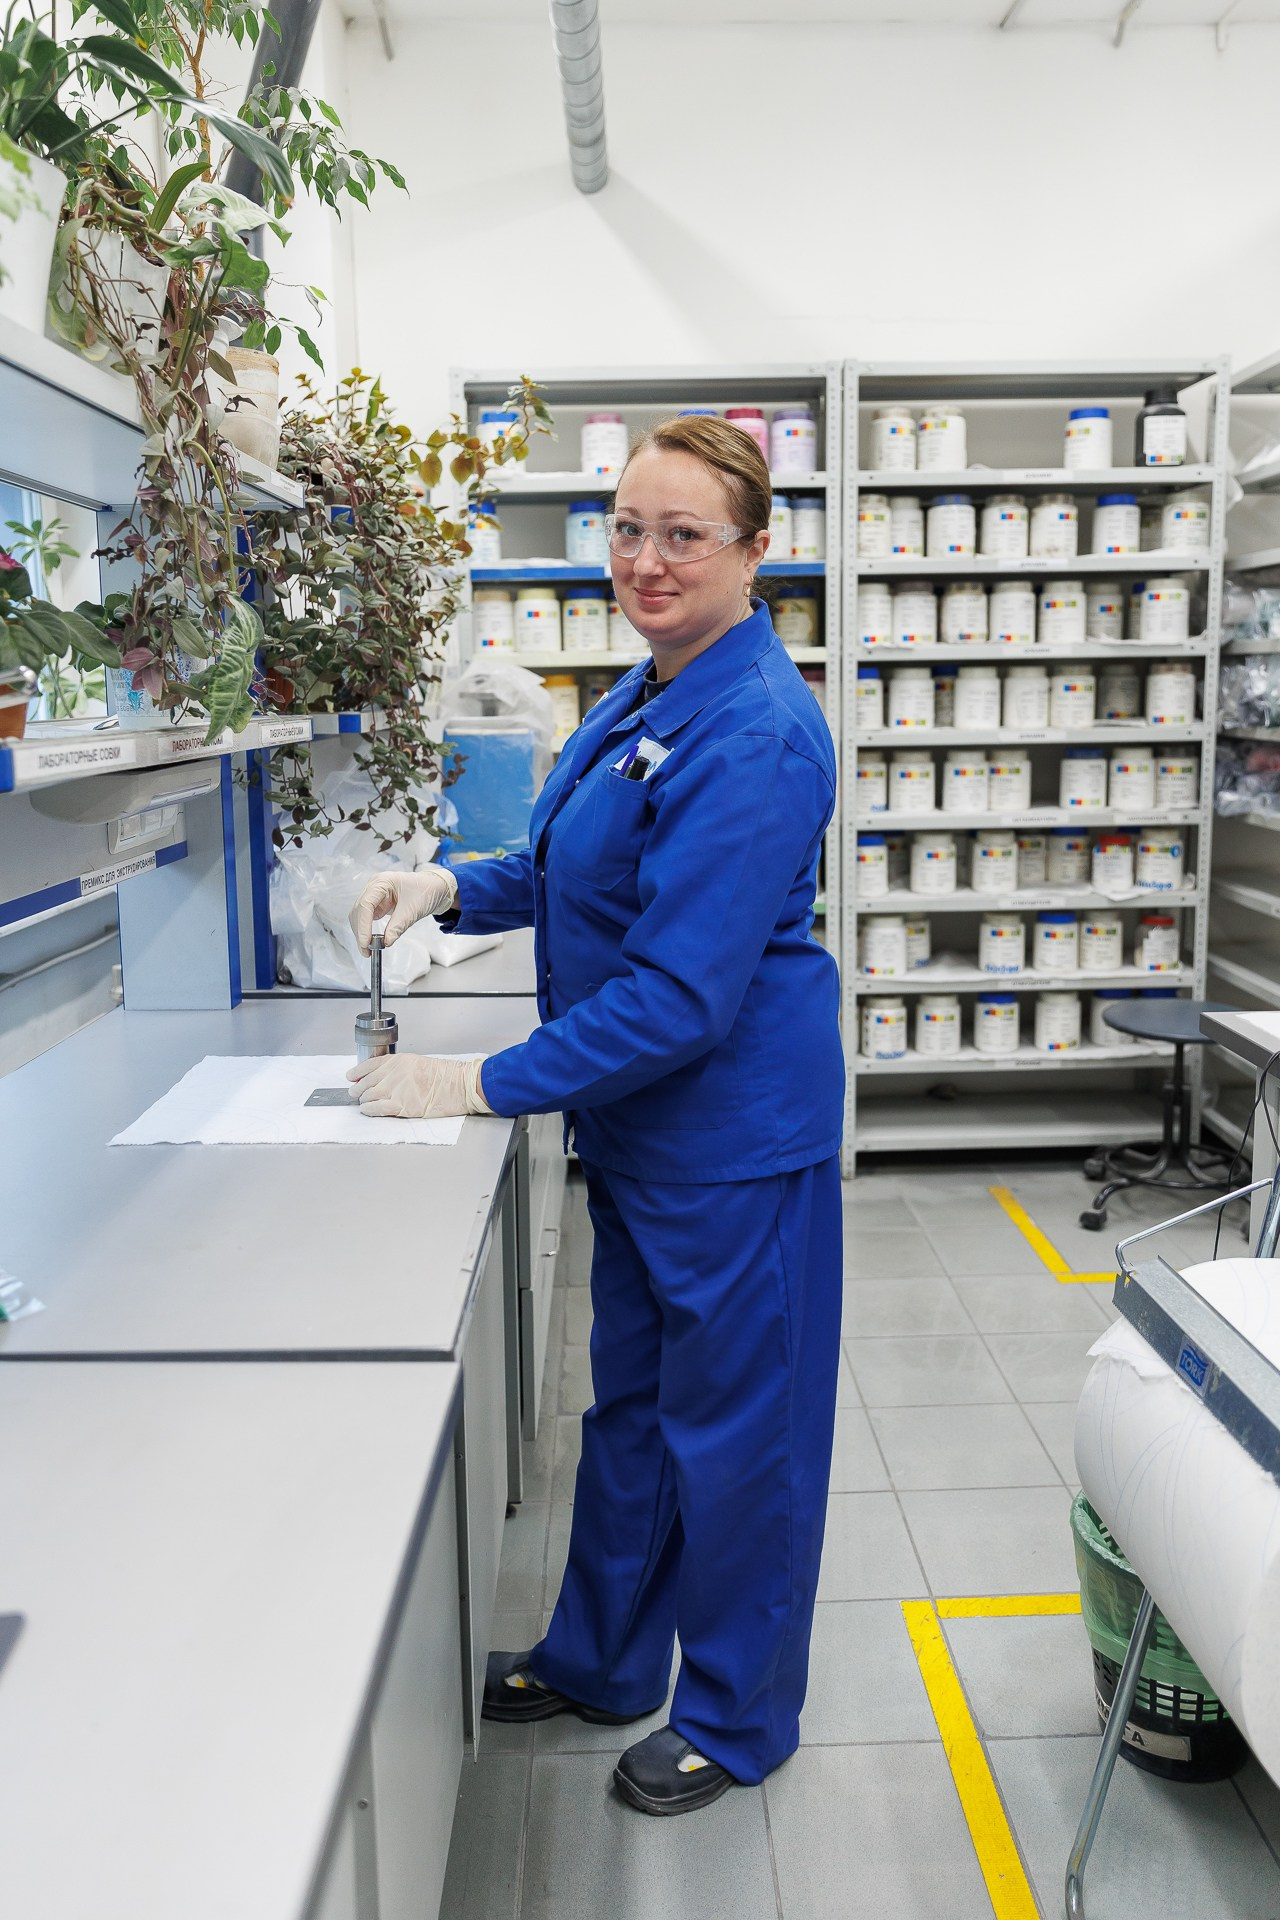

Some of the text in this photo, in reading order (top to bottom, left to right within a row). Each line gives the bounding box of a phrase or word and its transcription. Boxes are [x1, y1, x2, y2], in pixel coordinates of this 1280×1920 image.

[38, 746, 121, 769] ЛАБОРАТОРНЫЕ СОВКИ
[81, 855, 156, 891] ПРЕМИКС ДЛЯ ЭКСТРУДИРОВАНИЯ
[1182, 1353, 1204, 1383] TORK
